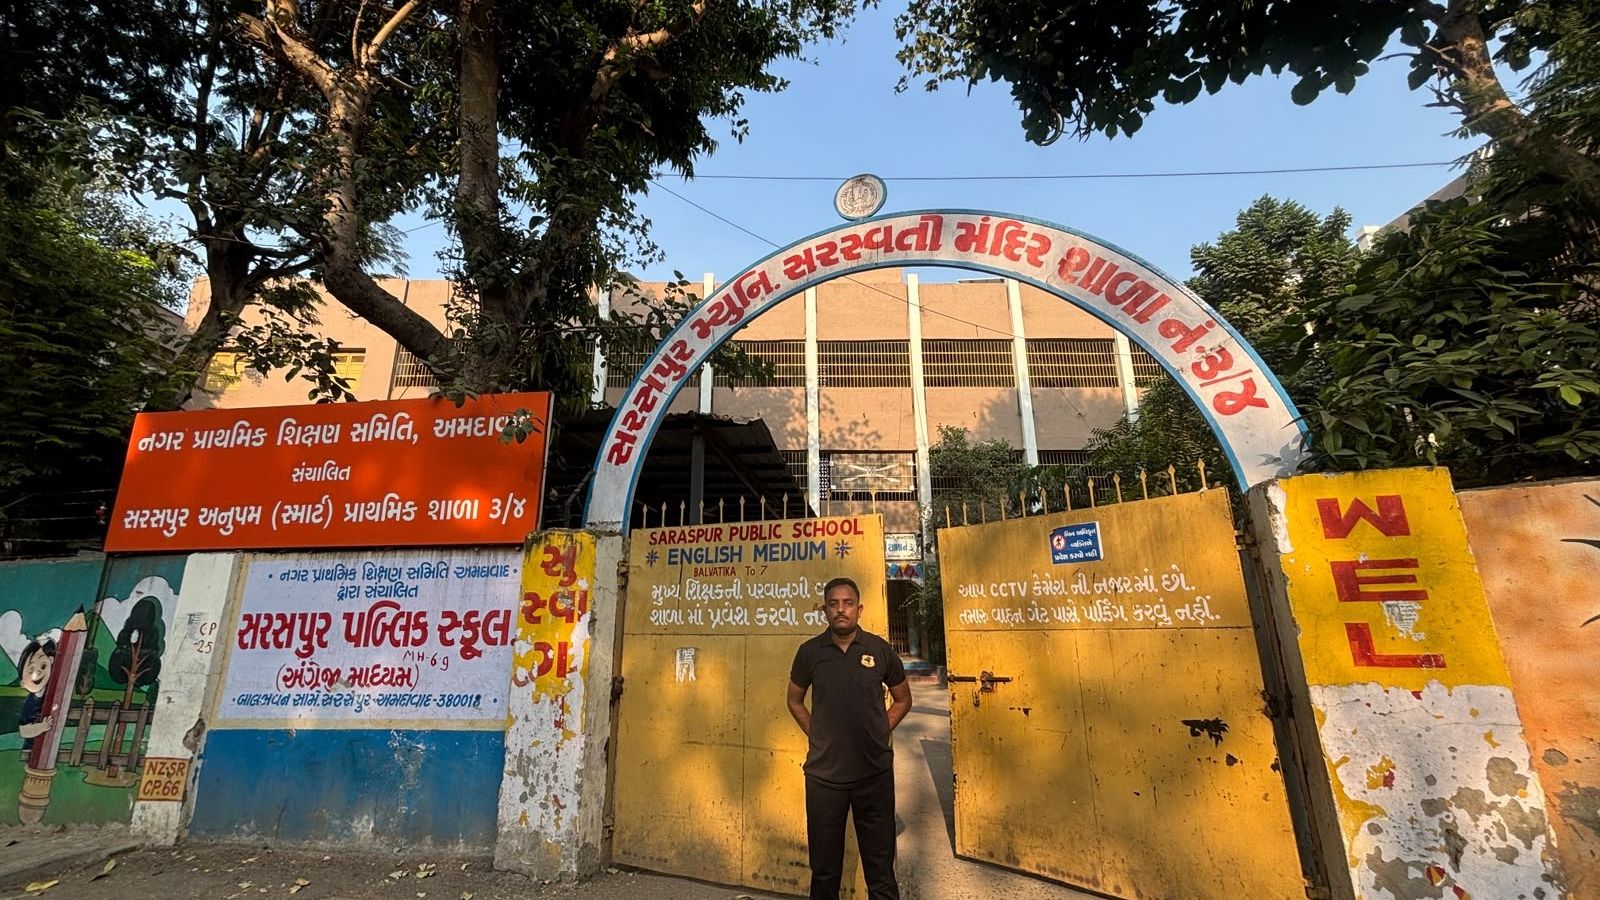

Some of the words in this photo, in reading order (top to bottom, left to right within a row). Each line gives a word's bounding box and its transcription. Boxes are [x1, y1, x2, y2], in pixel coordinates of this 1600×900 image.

[607, 339, 696, 466] સરસપુર
[783, 214, 944, 281] સરસ્વતી
[954, 216, 1053, 268] મંદિર
[1058, 246, 1173, 325] શાળા
[138, 431, 184, 452] નગર
[192, 419, 268, 449] પ્રાથમિક
[276, 417, 341, 448] શિક્ષણ
[350, 412, 419, 445] સમિતિ,
[291, 459, 351, 483] સંચાલિત
[123, 507, 190, 538] સરસપુર
[198, 505, 263, 536] અનુપમ
[271, 494, 334, 531] (સ્માર્ટ)
[343, 493, 418, 523] પ્રાથમિક
[427, 499, 479, 521] શાળા
[488, 492, 527, 525] ૩/૪
[648, 528, 722, 546] SARASPUR
[728, 523, 782, 541] PUBLIC
[792, 518, 864, 539] SCHOOL
[667, 545, 743, 566] ENGLISH
[753, 540, 826, 563] MEDIUM
[280, 569, 309, 582] નગર
[312, 563, 357, 583] પ્રાથમિક
[362, 561, 402, 583] શિક્ષણ
[406, 561, 449, 580] સમિતિ
[453, 565, 510, 579] અમદાવાદ
[693, 565, 736, 578] BALVATIKA
[760, 565, 768, 576] 7
[958, 584, 986, 598] આપ
[990, 581, 1027, 597] CCTV
[1032, 572, 1068, 596] કેમેરા
[1071, 573, 1091, 595] ની
[336, 585, 360, 601] દ્વારા
[364, 582, 418, 599] સંચાલિત
[651, 584, 681, 605] મુખ્ય
[685, 578, 742, 604] શિક્ષકની
[746, 576, 810, 599] પરવાનગી
[650, 609, 684, 626] શાળા
[708, 601, 750, 629] પ્રવેશ
[754, 600, 799, 626] કરવો
[991, 608, 1025, 627] વાહન
[1027, 600, 1050, 623] ગેટ
[1051, 598, 1080, 623] પાસે
[1132, 597, 1173, 626] કરવું
[199, 622, 217, 636] CP
[237, 612, 332, 659] સરસપુર
[342, 600, 428, 648] પબ્લિક
[348, 663, 420, 692] માધ્યમ)
[142, 780, 180, 796] CP.66
